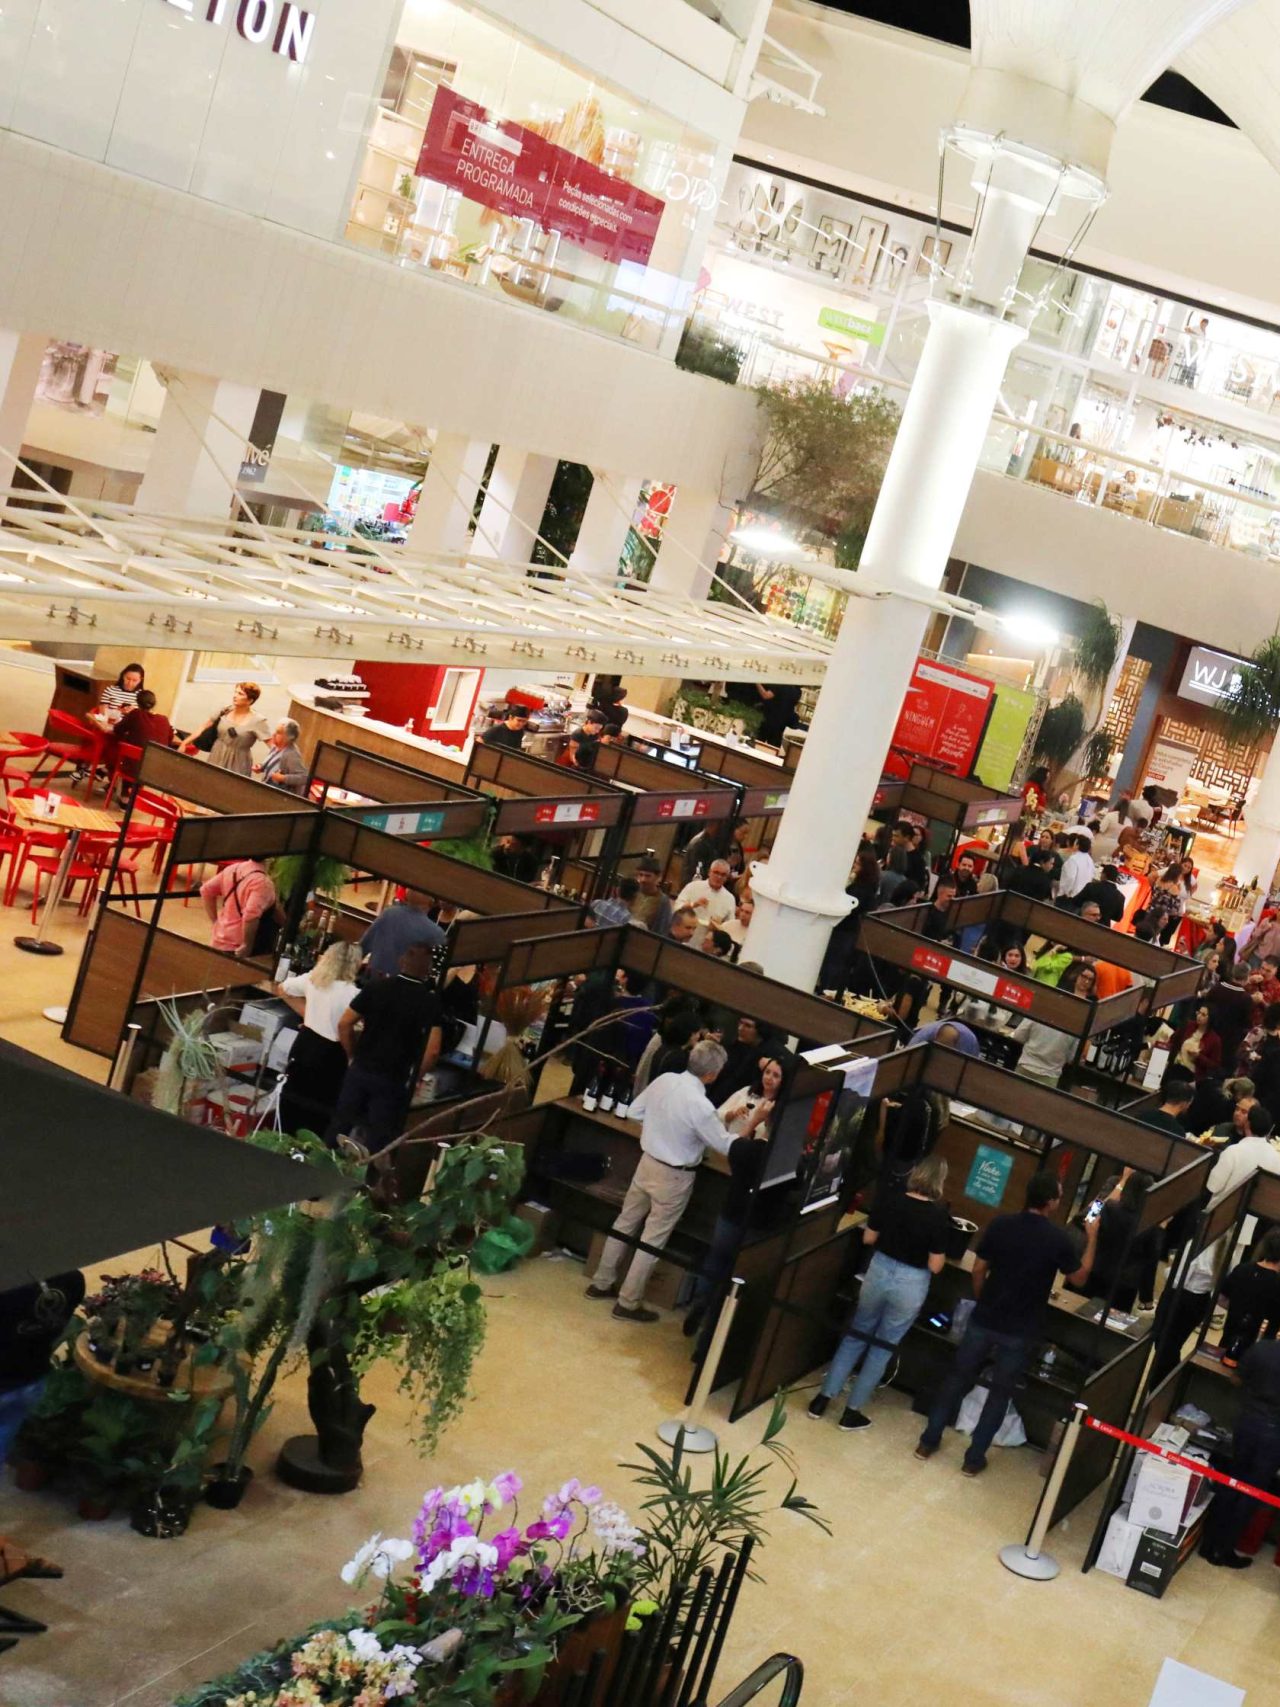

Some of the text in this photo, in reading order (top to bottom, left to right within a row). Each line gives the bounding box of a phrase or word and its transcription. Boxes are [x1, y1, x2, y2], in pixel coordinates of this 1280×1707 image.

[461, 138, 516, 177] ENTREGA
[455, 159, 534, 209] PROGRAMADA
[616, 209, 633, 225] com
[1193, 660, 1227, 689] WJ
